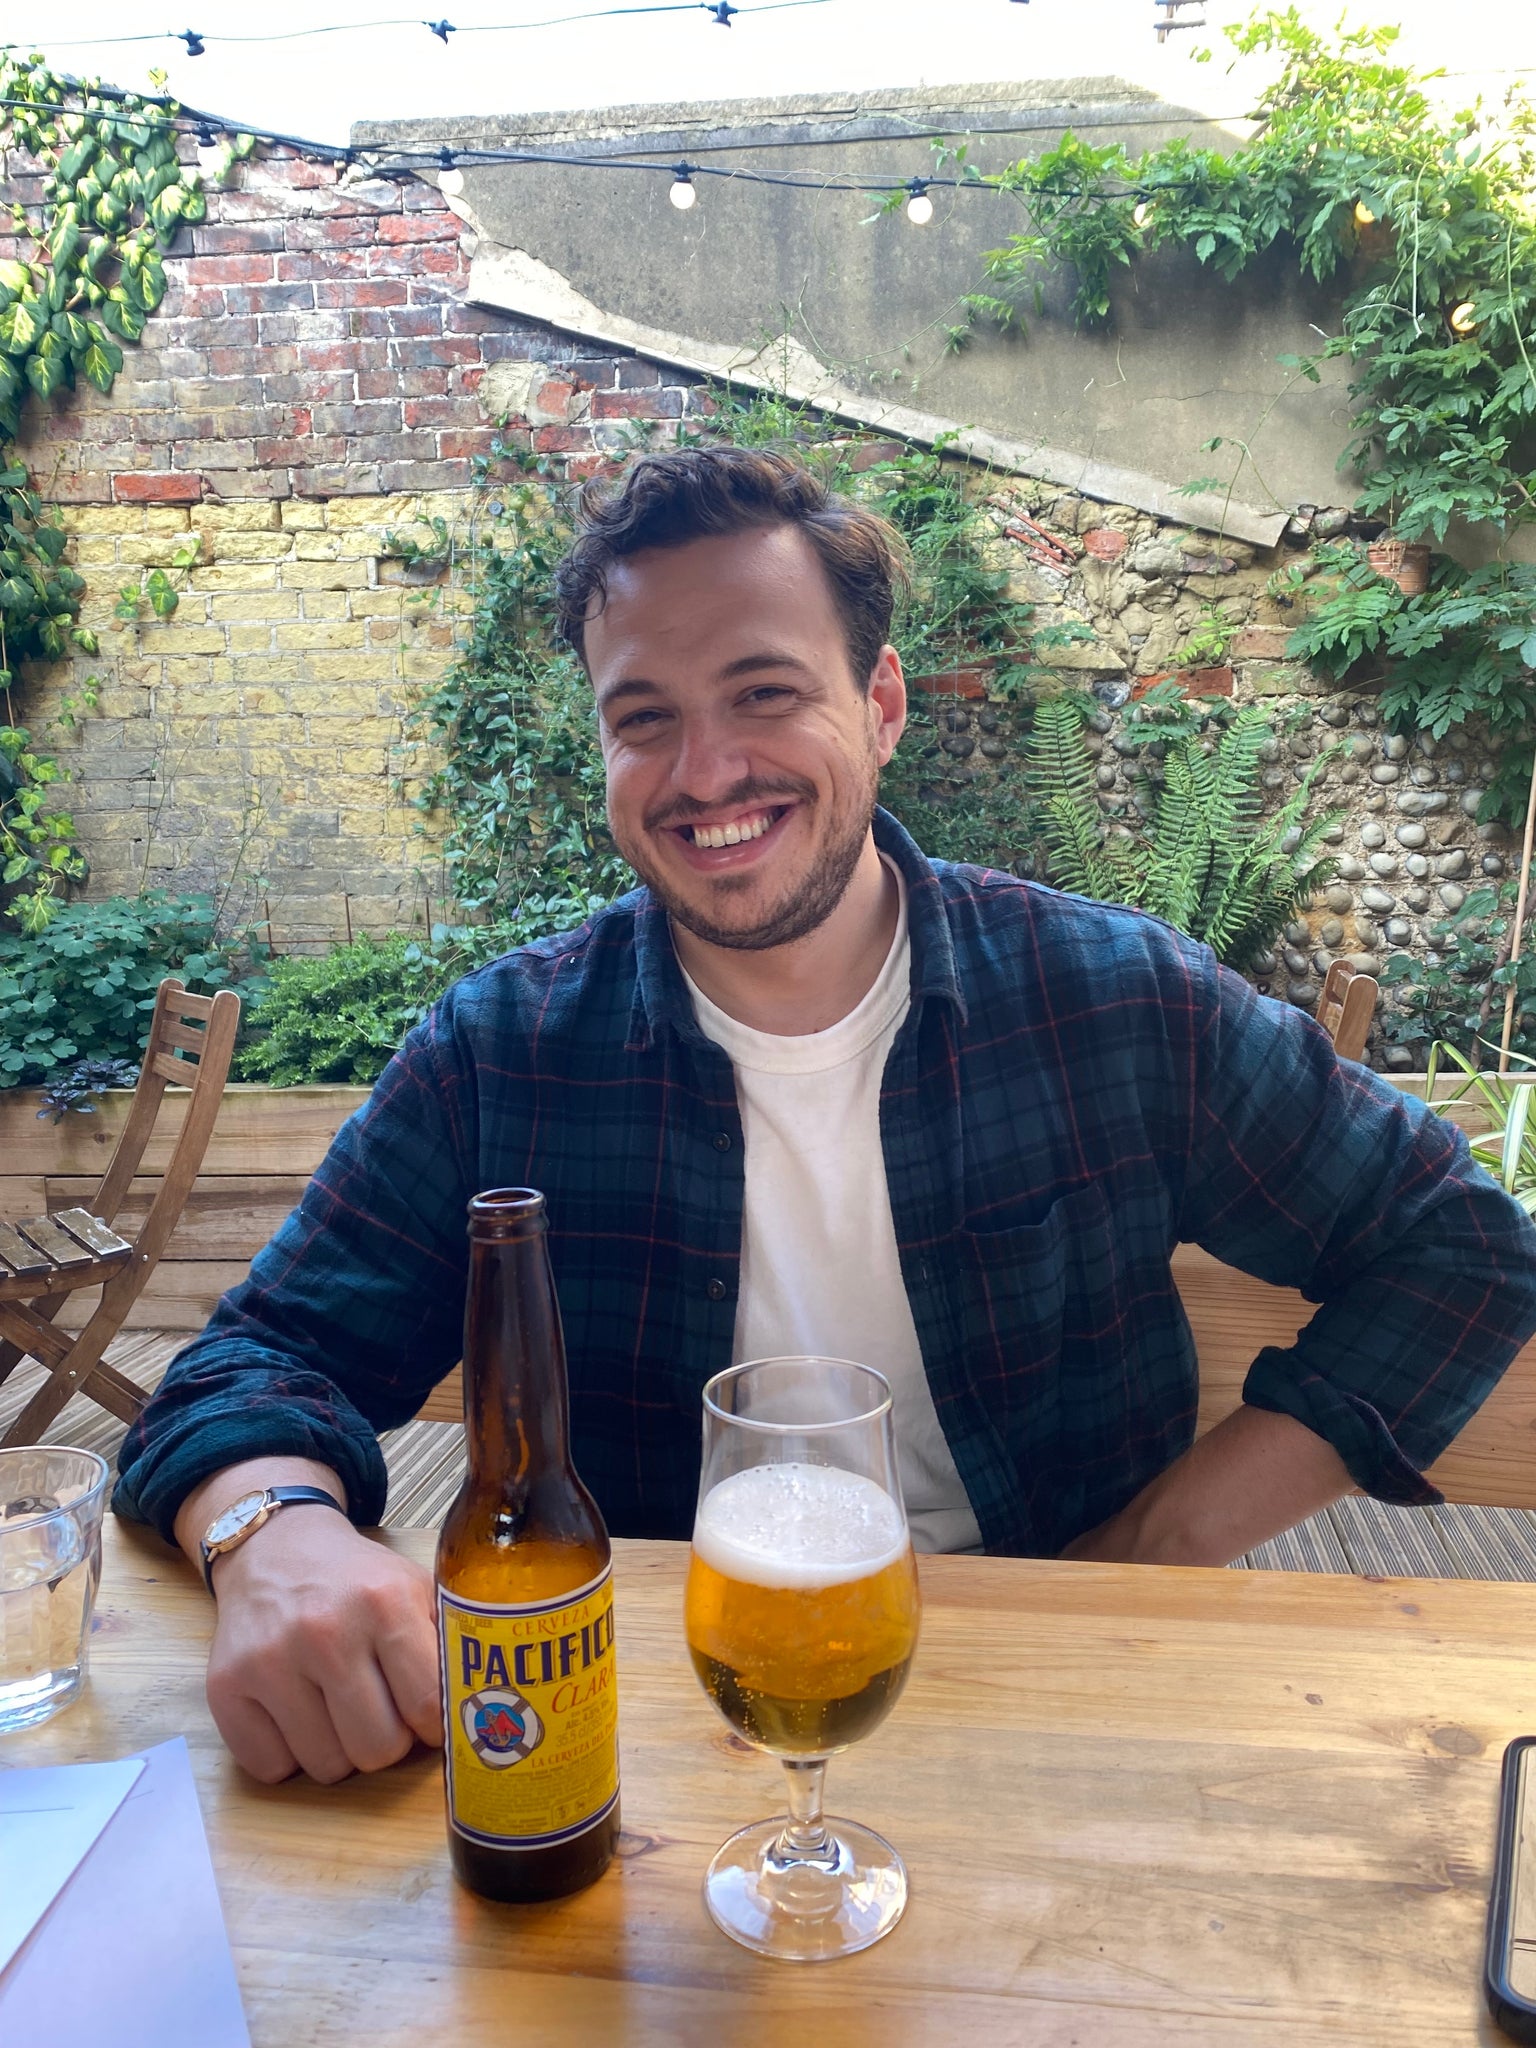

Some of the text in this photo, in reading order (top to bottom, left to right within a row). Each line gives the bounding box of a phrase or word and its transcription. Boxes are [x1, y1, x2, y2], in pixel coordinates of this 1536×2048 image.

[512, 1605, 590, 1636] CERVEZA
[460, 1602, 614, 1687] PACIFICO
[551, 1658, 614, 1714] CLARA
[532, 1758, 545, 1768] LA
[548, 1741, 590, 1765] CERVEZA
